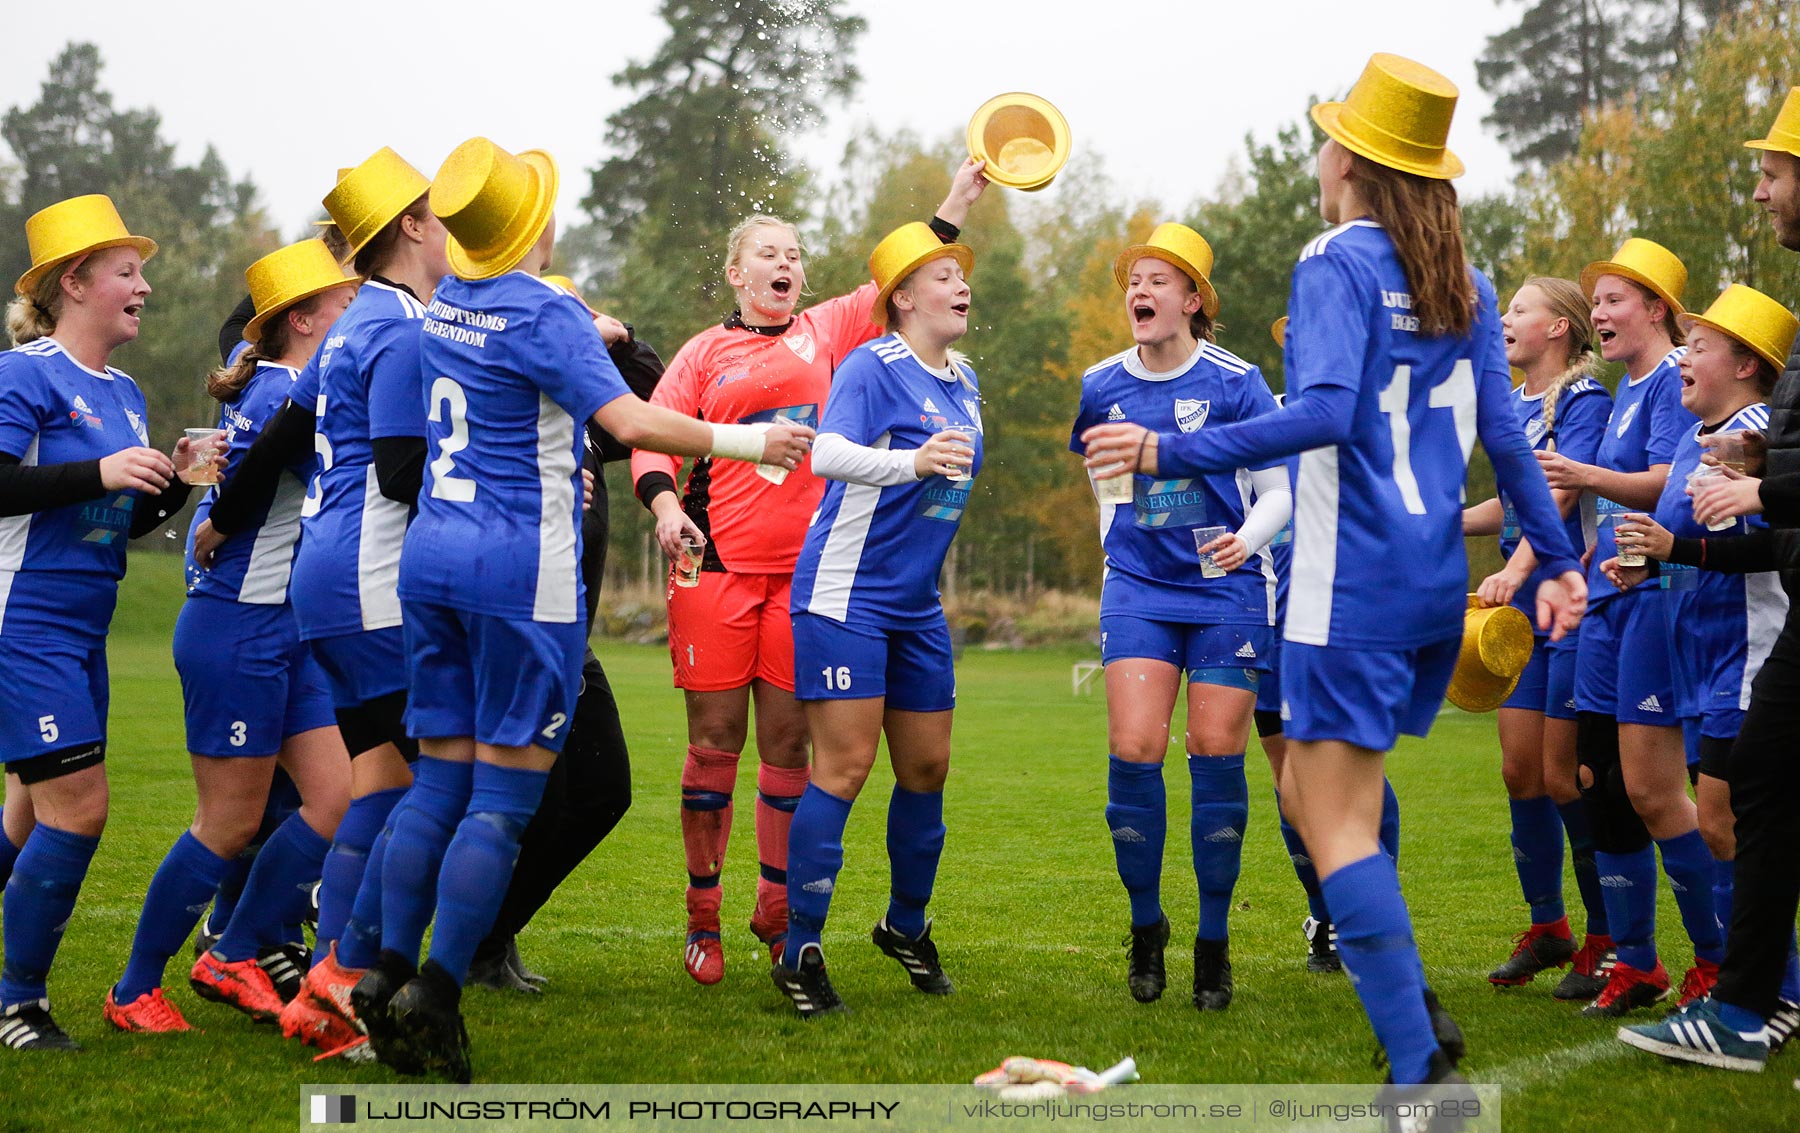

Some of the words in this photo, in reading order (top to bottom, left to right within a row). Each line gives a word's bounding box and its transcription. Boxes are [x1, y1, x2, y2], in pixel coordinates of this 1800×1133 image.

[422, 317, 488, 348] EGENDOM
[429, 376, 477, 502] 2
[1378, 358, 1478, 516] 11
[686, 644, 695, 667] 1
[822, 666, 852, 691] 16
[38, 714, 59, 744] 5
[229, 720, 248, 748] 3
[541, 712, 567, 739] 2
